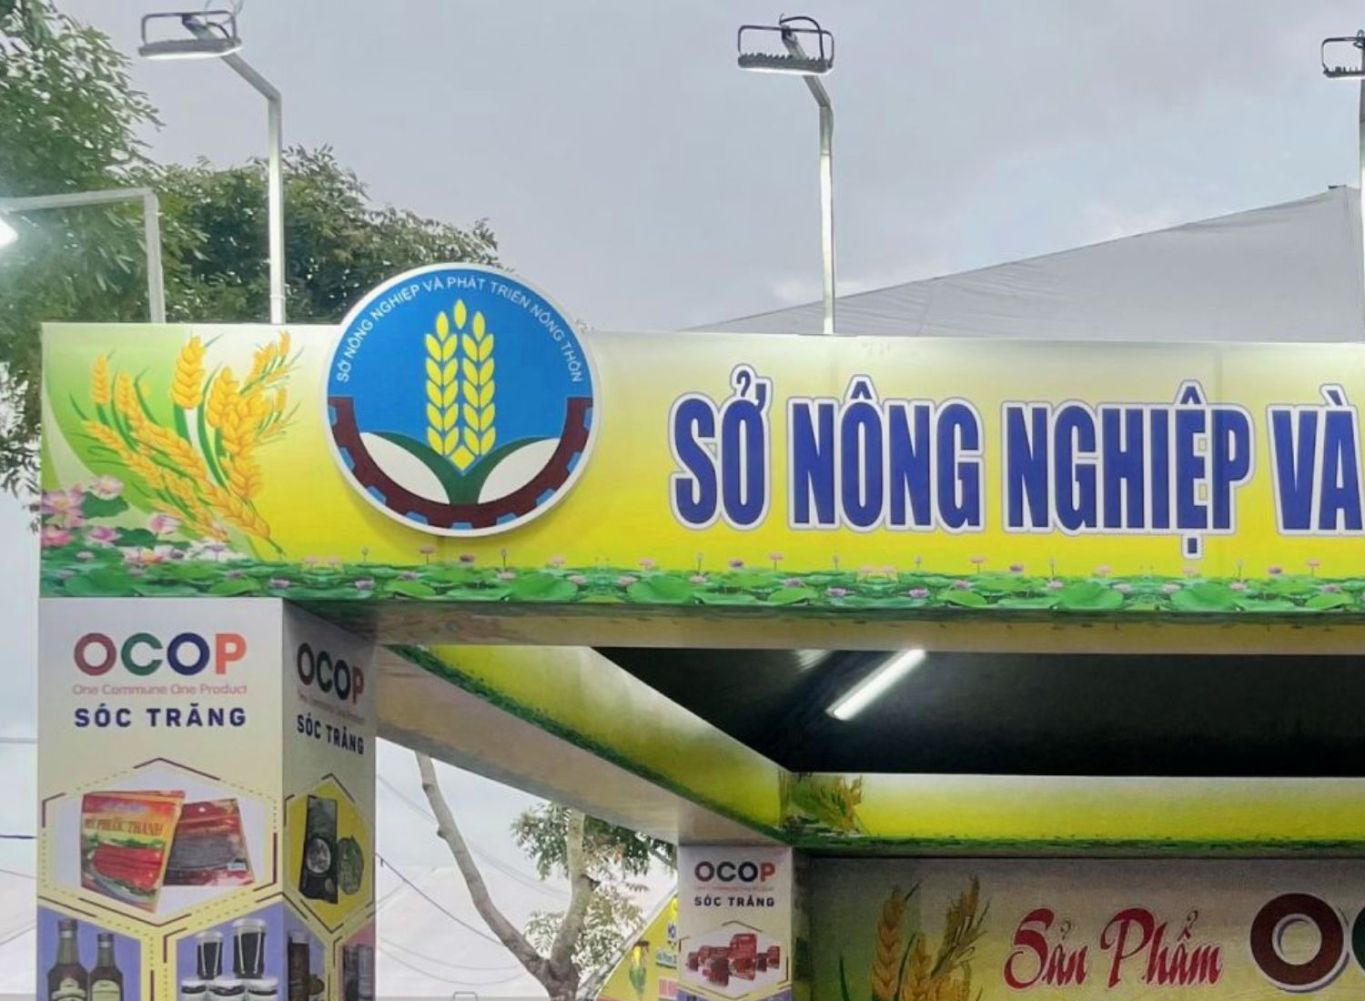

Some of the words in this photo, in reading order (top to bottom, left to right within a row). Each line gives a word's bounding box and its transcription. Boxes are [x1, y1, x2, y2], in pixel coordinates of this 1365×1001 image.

[344, 321, 374, 360] NÔNG
[447, 276, 485, 290] PHÁT
[530, 304, 564, 343] NÔNG
[561, 342, 583, 383] THÔN
[673, 368, 768, 527] SỞ
[791, 379, 982, 528] NÔNG
[1006, 385, 1250, 555] NGHIỆP
[1272, 388, 1364, 532] VÀ
[73, 632, 247, 676] OCOP
[296, 642, 365, 704] OCOP
[73, 684, 99, 695] One
[101, 684, 167, 696] Commune
[170, 684, 197, 695] One
[200, 683, 247, 695] Product
[75, 702, 131, 727] SÓC
[146, 703, 246, 727] TRĂNG
[297, 712, 321, 739] SÓC
[325, 723, 364, 755] TRĂNG
[694, 861, 776, 882] OCOP
[695, 894, 722, 907] SÓC
[1003, 907, 1088, 989] Sản
[1100, 907, 1223, 989] Phẩm
